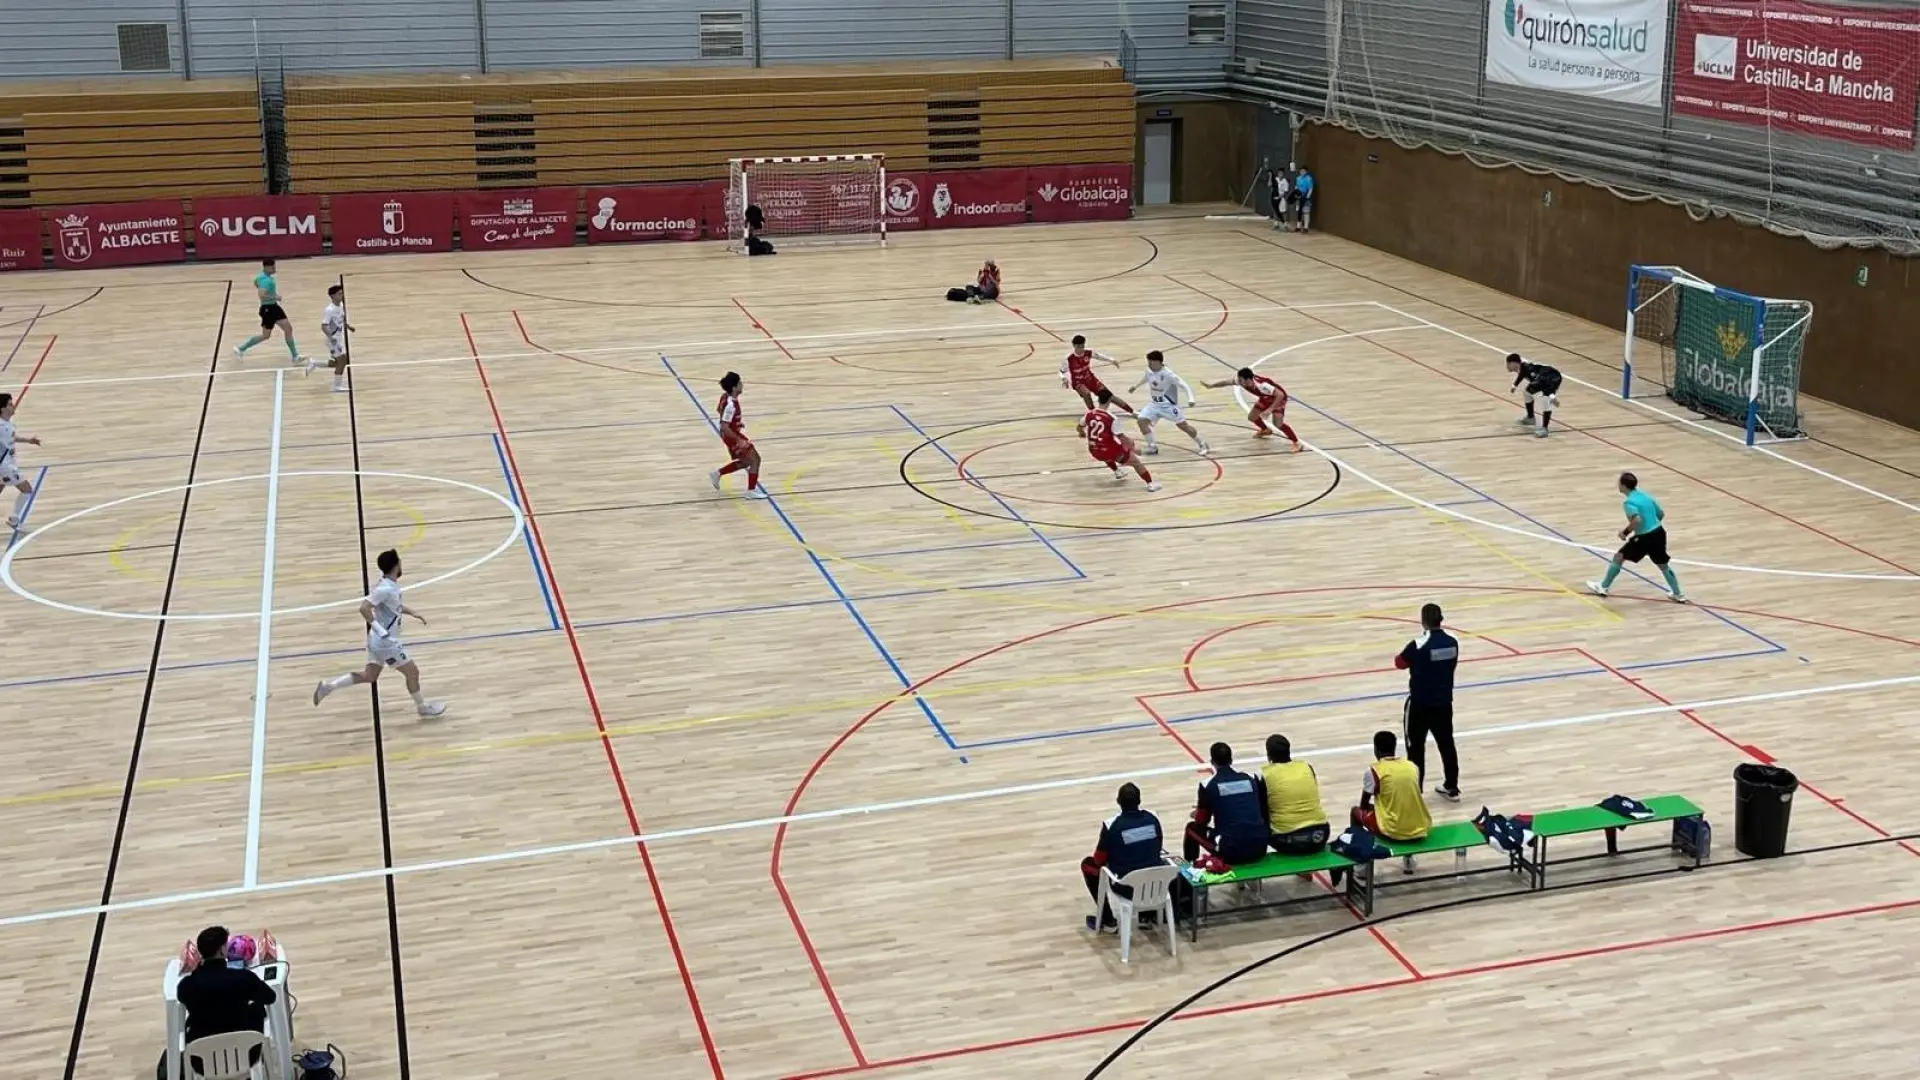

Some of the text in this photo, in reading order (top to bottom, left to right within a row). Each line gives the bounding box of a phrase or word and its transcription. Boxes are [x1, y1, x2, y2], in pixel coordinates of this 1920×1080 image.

[1522, 13, 1648, 52] quirónsalud
[1746, 38, 1863, 71] Universidad de
[1528, 56, 1640, 82] La salud persona a persona
[1744, 64, 1894, 102] Castilla-La Mancha
[1060, 186, 1128, 204] Globalcaja
[953, 200, 1026, 215] indoorland
[98, 217, 178, 234] Ayuntamiento
[221, 214, 317, 237] UCLM
[530, 215, 568, 223] ALBACETE
[610, 217, 696, 231] formacion@
[101, 230, 180, 250] ALBACETE
[402, 236, 433, 246] Mancha
[484, 224, 555, 241] Con el deporte
[2, 248, 26, 258] Ruiz
[1090, 419, 1105, 441] 22
